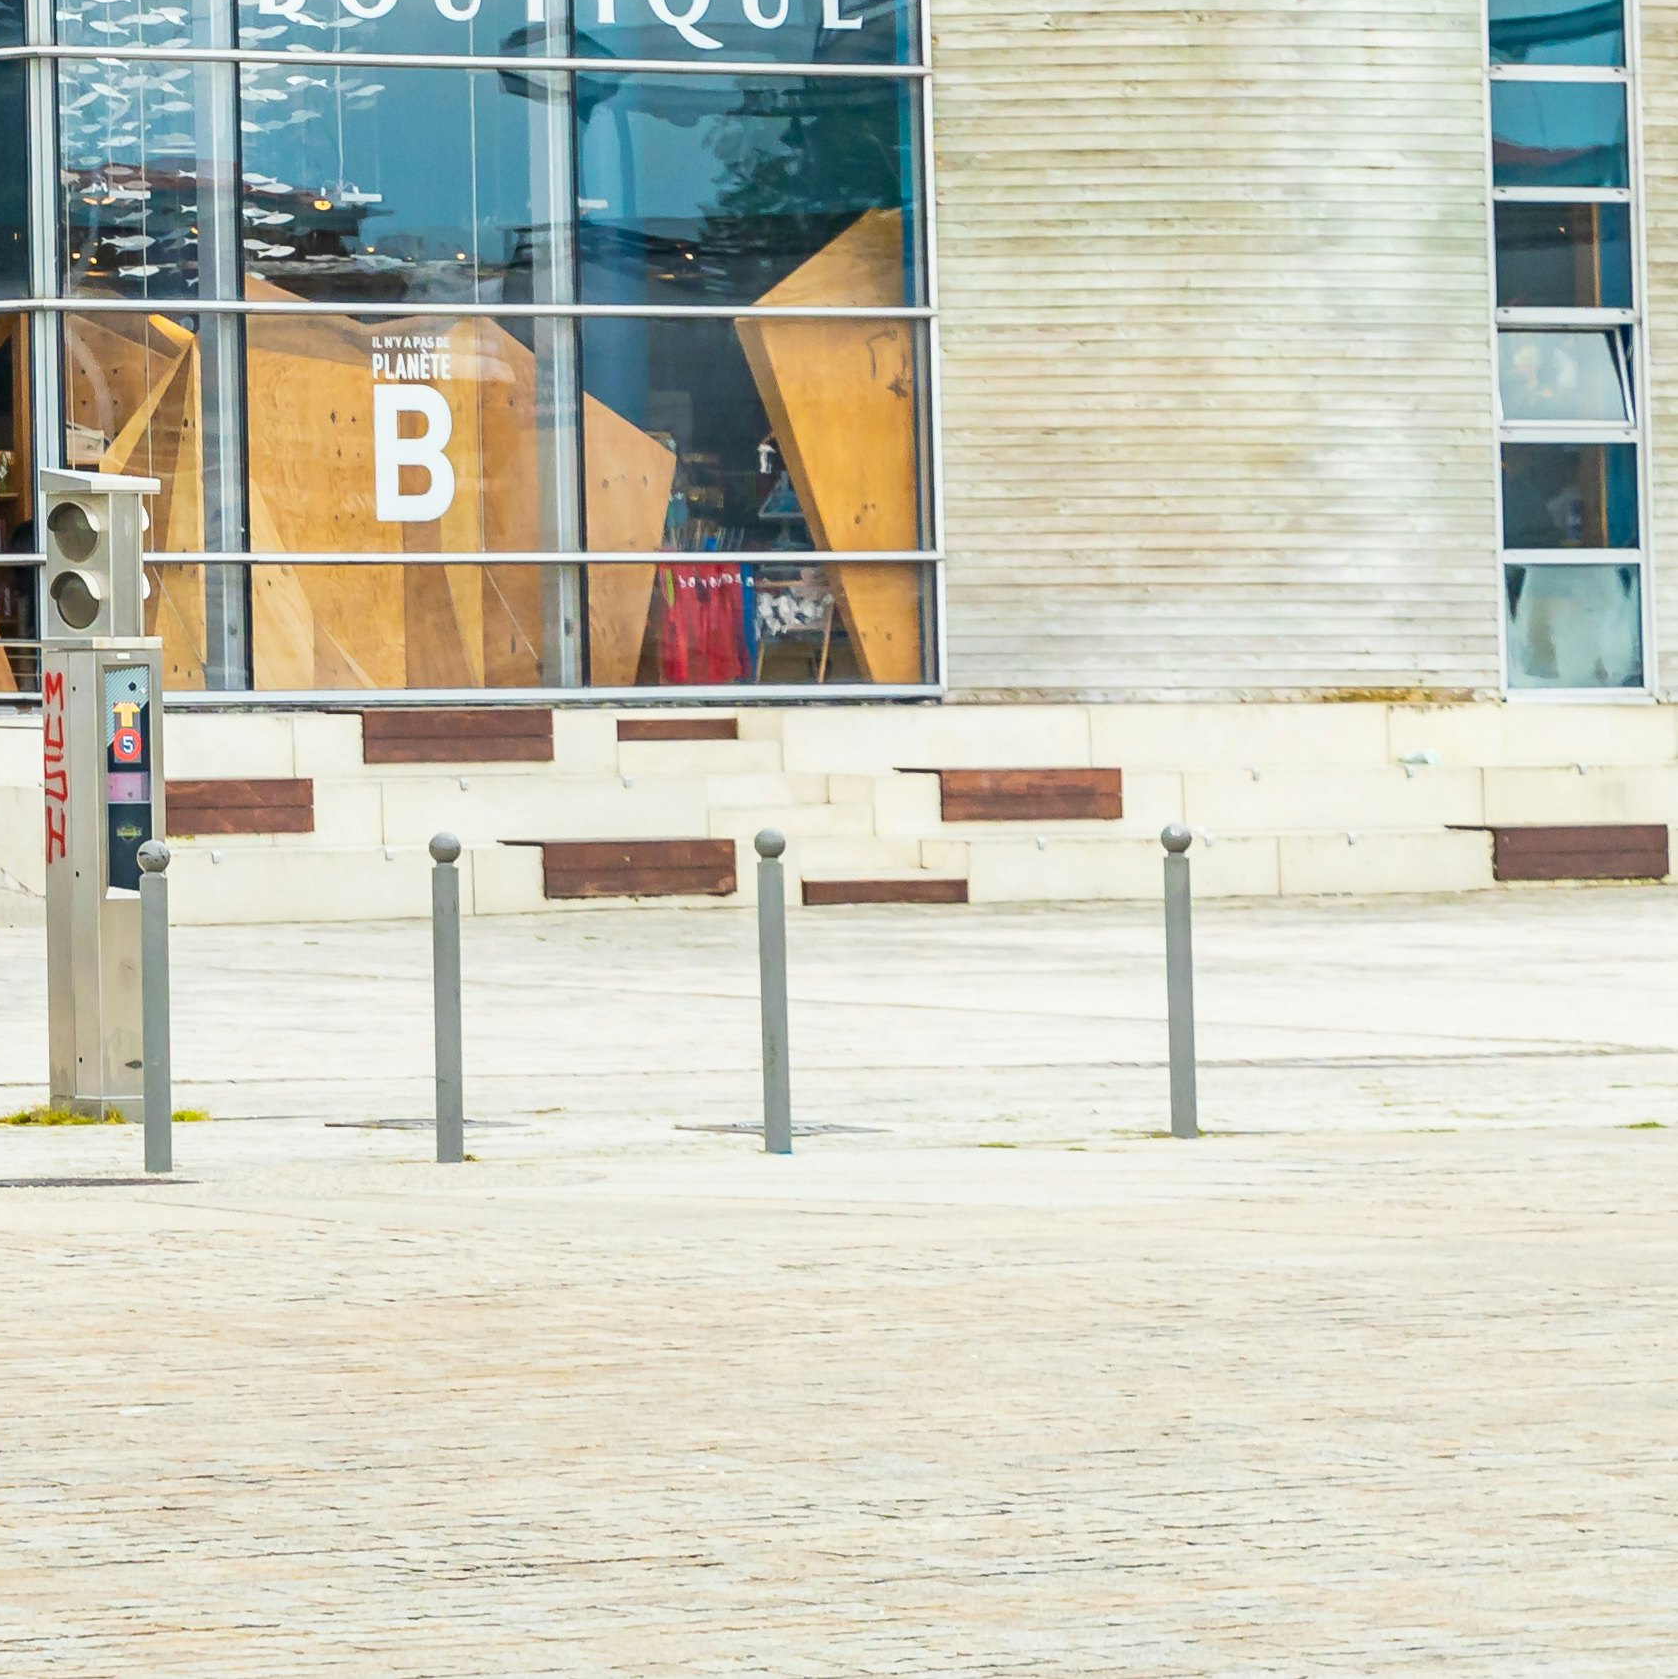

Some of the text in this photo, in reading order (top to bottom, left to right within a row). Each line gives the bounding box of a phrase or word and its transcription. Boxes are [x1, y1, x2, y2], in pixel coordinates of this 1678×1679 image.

[372, 336, 382, 348] IL
[403, 336, 413, 348] A
[414, 336, 435, 349] PAS
[436, 336, 450, 349] DE
[372, 348, 452, 380] PLANÈTE
[373, 384, 455, 522] B
[122, 735, 134, 754] 5
